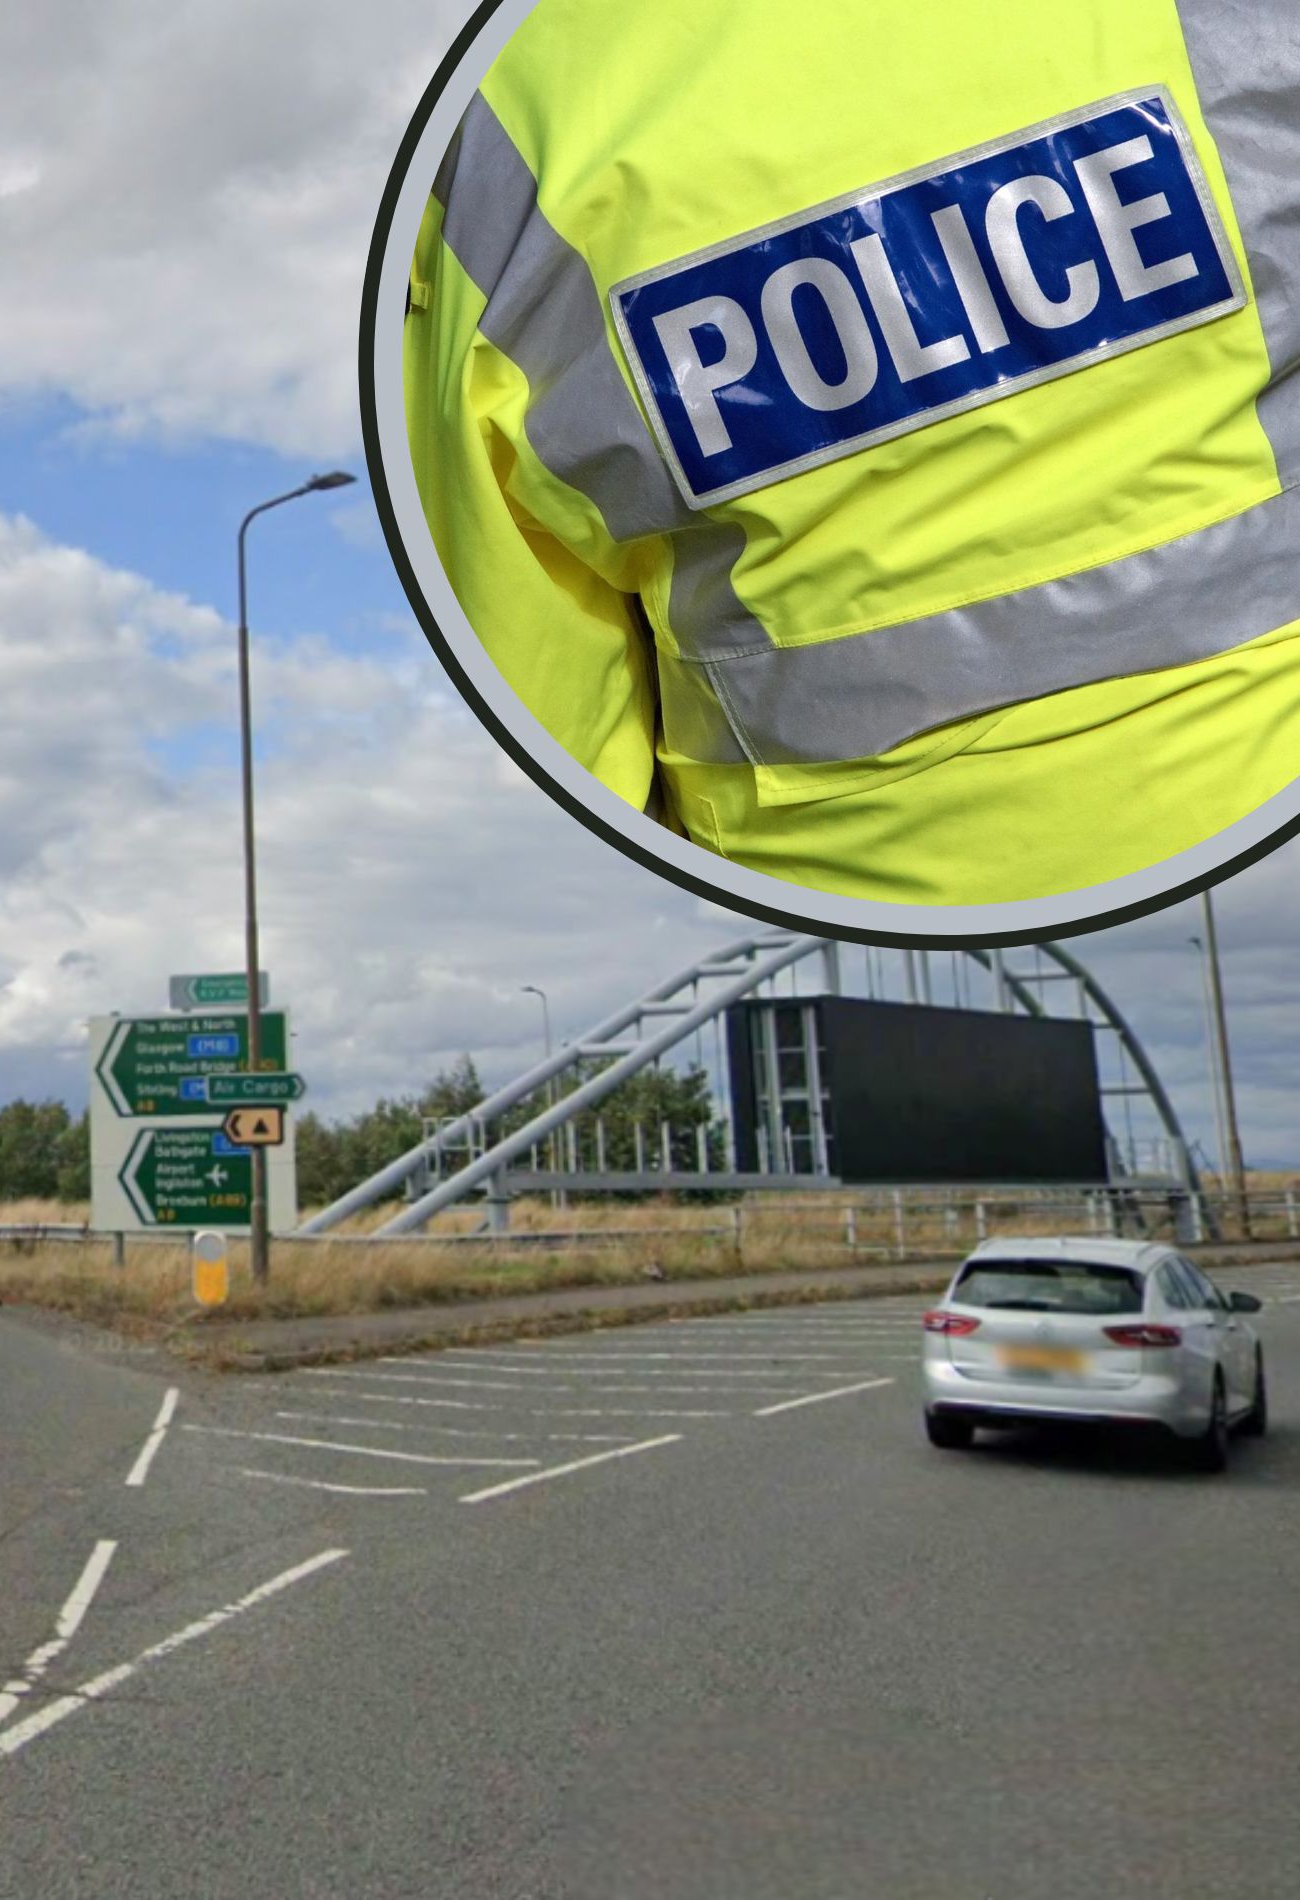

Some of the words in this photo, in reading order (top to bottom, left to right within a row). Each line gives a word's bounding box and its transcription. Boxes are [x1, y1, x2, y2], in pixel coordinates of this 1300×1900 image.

[651, 134, 1199, 458] POLICE
[136, 1019, 156, 1033] The
[159, 1018, 190, 1032] West
[192, 1018, 200, 1032] &
[204, 1017, 237, 1031] North
[136, 1041, 185, 1056] Glasgow
[196, 1038, 230, 1052] (M8)
[136, 1061, 167, 1074] Forth
[169, 1061, 200, 1073] Road
[202, 1060, 237, 1075] Bridge
[214, 1080, 236, 1094] Air
[243, 1079, 288, 1096] Cargo
[155, 1145, 206, 1159] Bathgate
[157, 1163, 195, 1177] Airport
